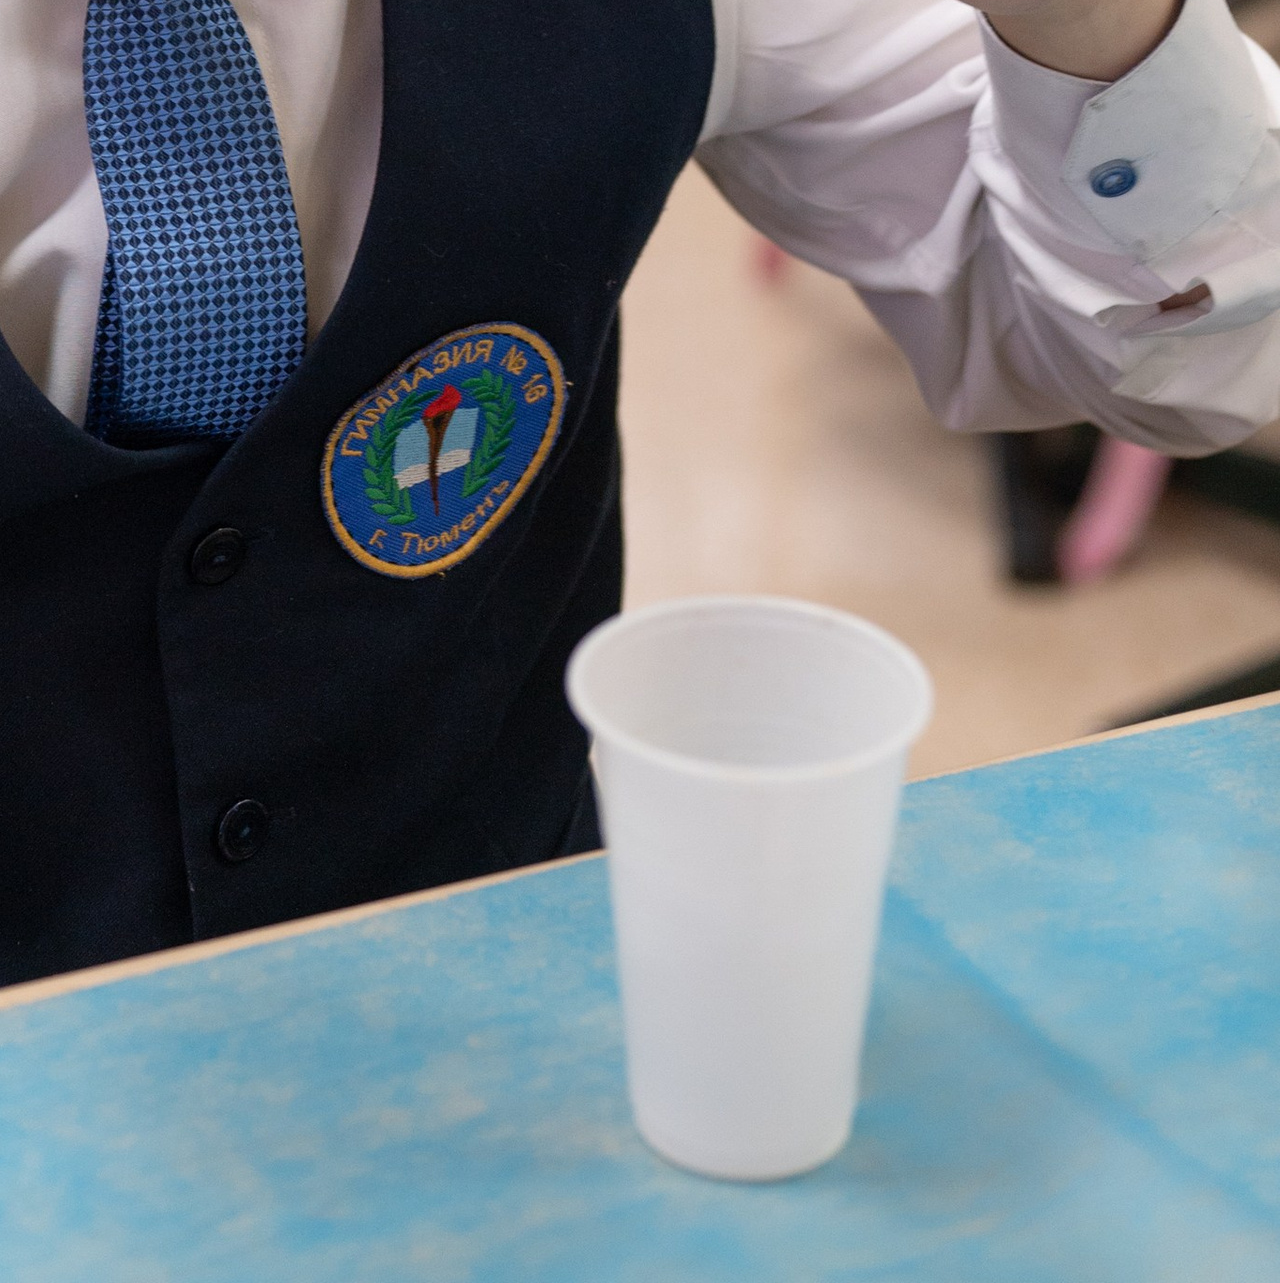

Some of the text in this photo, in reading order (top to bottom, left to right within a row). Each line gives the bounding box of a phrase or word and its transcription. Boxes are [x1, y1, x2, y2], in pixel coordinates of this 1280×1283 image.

[340, 338, 548, 457] ГИМНАЗИЯ № 16
[401, 480, 510, 554] Тюмень
